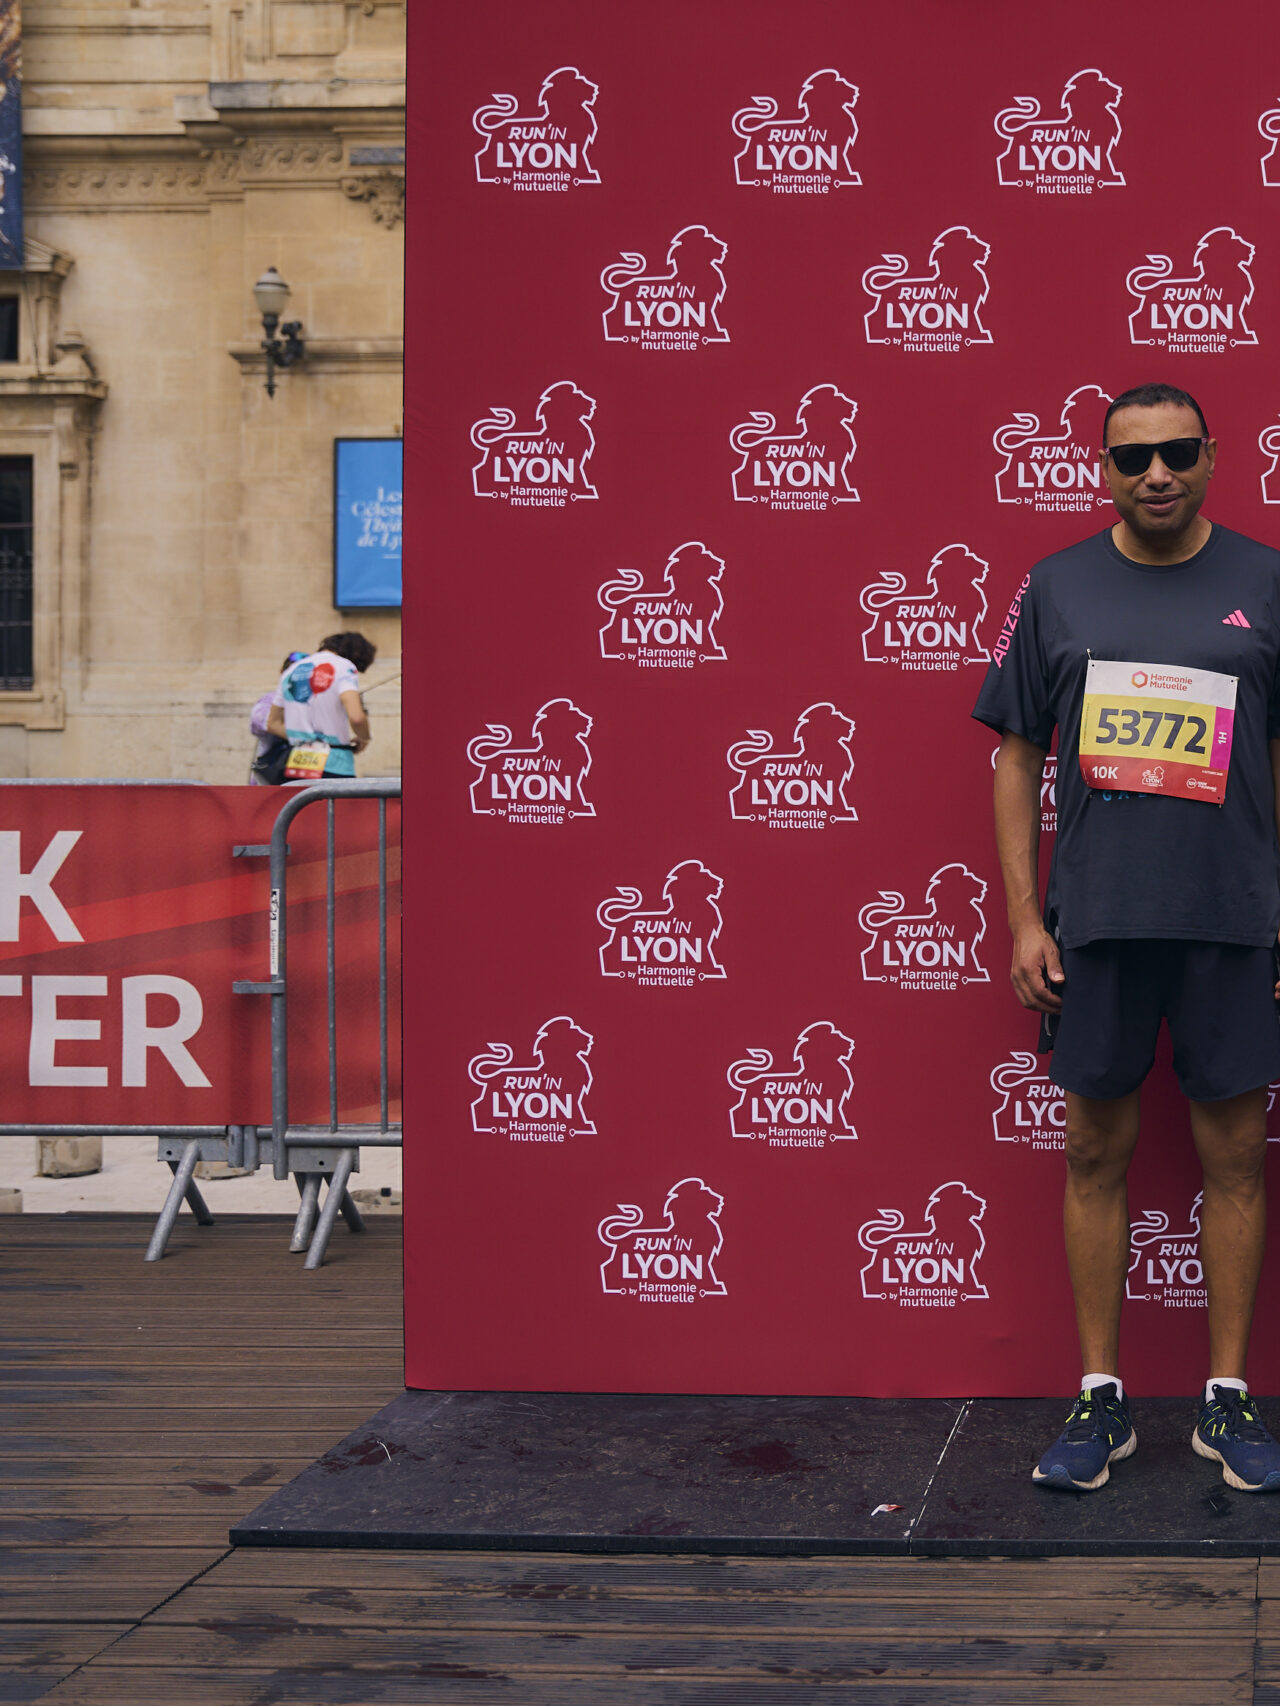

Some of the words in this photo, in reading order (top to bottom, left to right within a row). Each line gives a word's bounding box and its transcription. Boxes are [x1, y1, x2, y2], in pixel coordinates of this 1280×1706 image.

[508, 123, 567, 140] RUN'IN
[1030, 126, 1090, 142] RUN'IN
[497, 142, 576, 168] LYON
[1019, 145, 1100, 171] LYON
[502, 176, 512, 185] by
[513, 171, 570, 181] Harmonie
[1025, 179, 1035, 188] by
[1036, 173, 1094, 184] Harmonie
[514, 182, 568, 191] mutuelle
[1037, 184, 1092, 194] mutuelle
[636, 282, 695, 298] RUN'IN
[1162, 284, 1222, 301] RUN'IN
[625, 301, 705, 327] LYON
[1151, 304, 1233, 329] LYON
[630, 335, 640, 344] by
[641, 330, 699, 340] Harmonie
[1157, 337, 1167, 347] by
[1168, 332, 1227, 342] Harmonie
[642, 340, 697, 350] mutuelle
[1169, 343, 1225, 353] mutuelle
[765, 441, 825, 458] RUN'IN
[1029, 443, 1090, 459] RUN'IN
[754, 461, 835, 486] LYON
[1018, 462, 1100, 488] LYON
[760, 495, 770, 504] by
[771, 489, 829, 500] Harmonie
[1023, 496, 1034, 505] by
[1035, 491, 1094, 501] Harmonie
[771, 500, 826, 510] mutuelle
[1036, 502, 1091, 511] mutuelle
[633, 599, 692, 615] RUN'IN
[993, 573, 1031, 669] ADIZERO
[622, 618, 702, 644] LYON
[627, 652, 637, 661] by
[638, 647, 696, 658] Harmonie
[639, 658, 694, 668] mutuelle
[1149, 681, 1188, 691] Mutuelle
[1150, 673, 1193, 685] Harmonie
[1095, 708, 1207, 755] 53772
[1218, 731, 1227, 745] 1H
[502, 755, 561, 772] RUN'IN
[1091, 766, 1119, 780] 10K
[492, 773, 571, 800] LYON
[497, 807, 507, 817] by
[508, 803, 565, 813] Harmonie
[509, 814, 563, 824] mutuelle
[894, 921, 954, 938] RUN'IN
[883, 940, 965, 966] LYON
[889, 974, 899, 984] by
[900, 969, 959, 979] Harmonie
[901, 980, 956, 990] mutuelle
[763, 1079, 822, 1095] RUN'IN
[752, 1097, 832, 1124] LYON
[758, 1131, 768, 1141] by
[769, 1126, 827, 1137] Harmonie
[769, 1137, 824, 1147] mutuelle
[633, 1235, 692, 1251] RUN'IN
[623, 1253, 702, 1279] LYON
[628, 1287, 638, 1296] by
[639, 1282, 696, 1292] Harmonie
[640, 1293, 694, 1303] mutuelle
